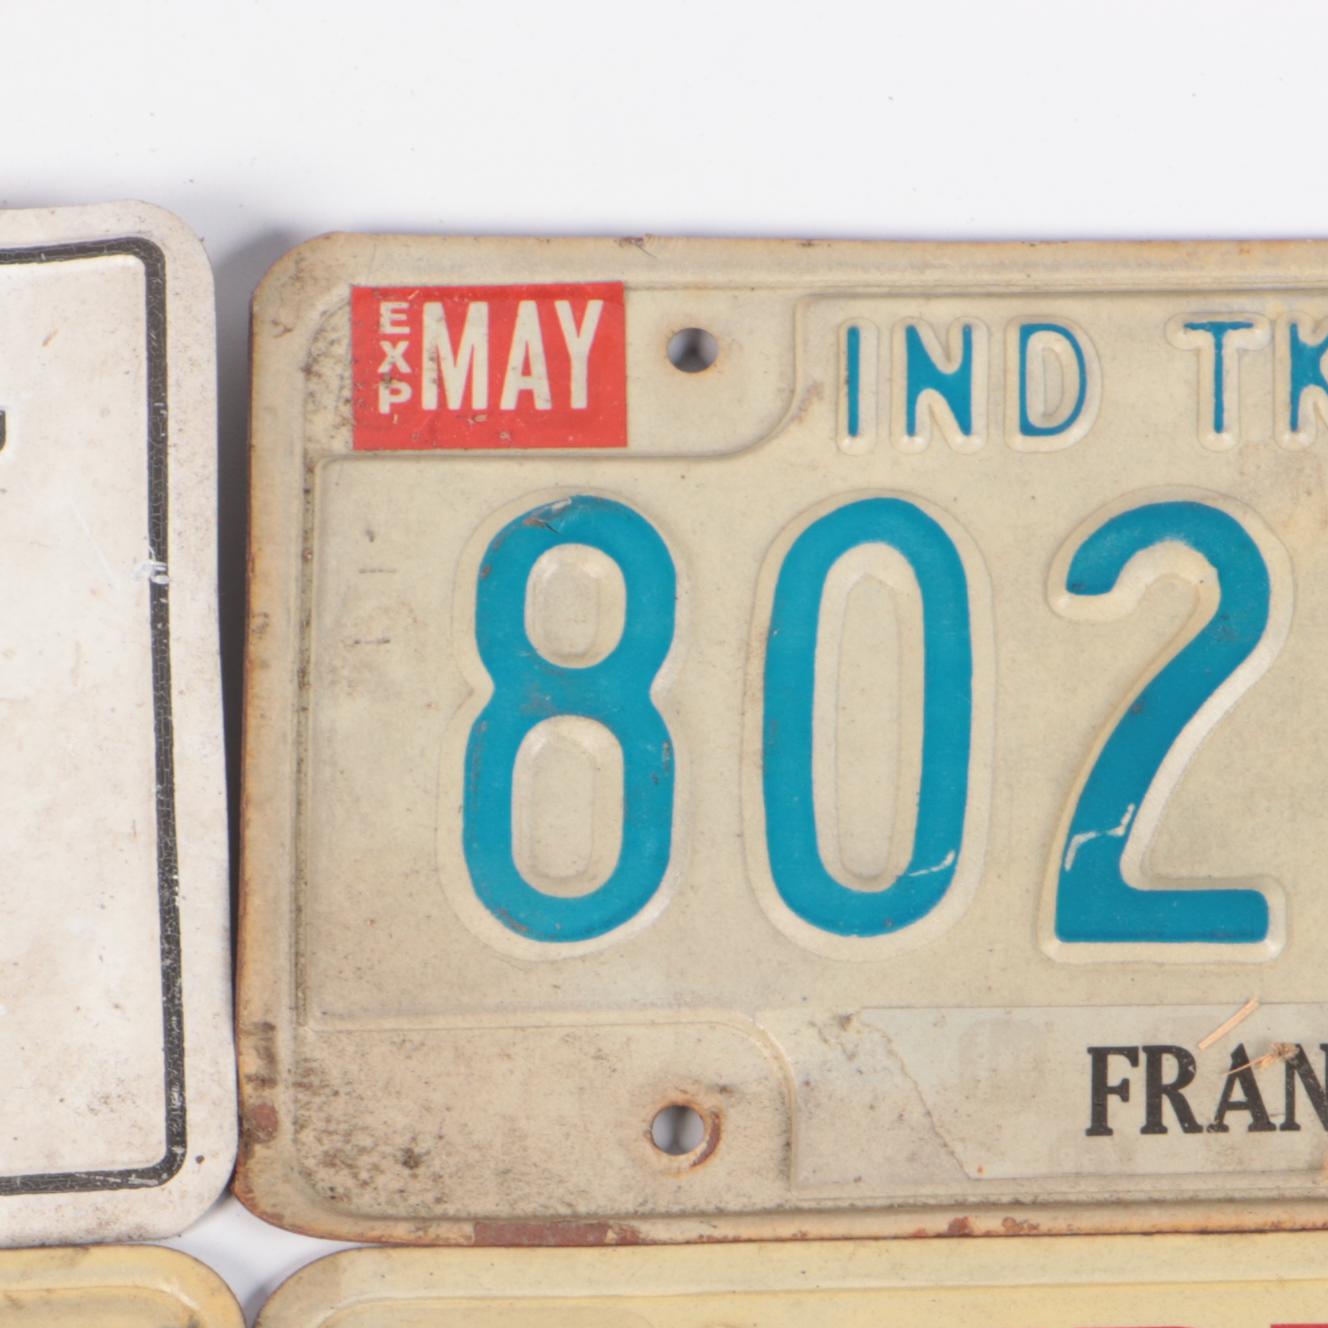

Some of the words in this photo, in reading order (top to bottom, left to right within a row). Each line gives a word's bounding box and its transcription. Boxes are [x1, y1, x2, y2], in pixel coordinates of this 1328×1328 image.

[378, 302, 412, 414] EXP
[421, 300, 604, 411] MAY
[846, 322, 1088, 438] IND
